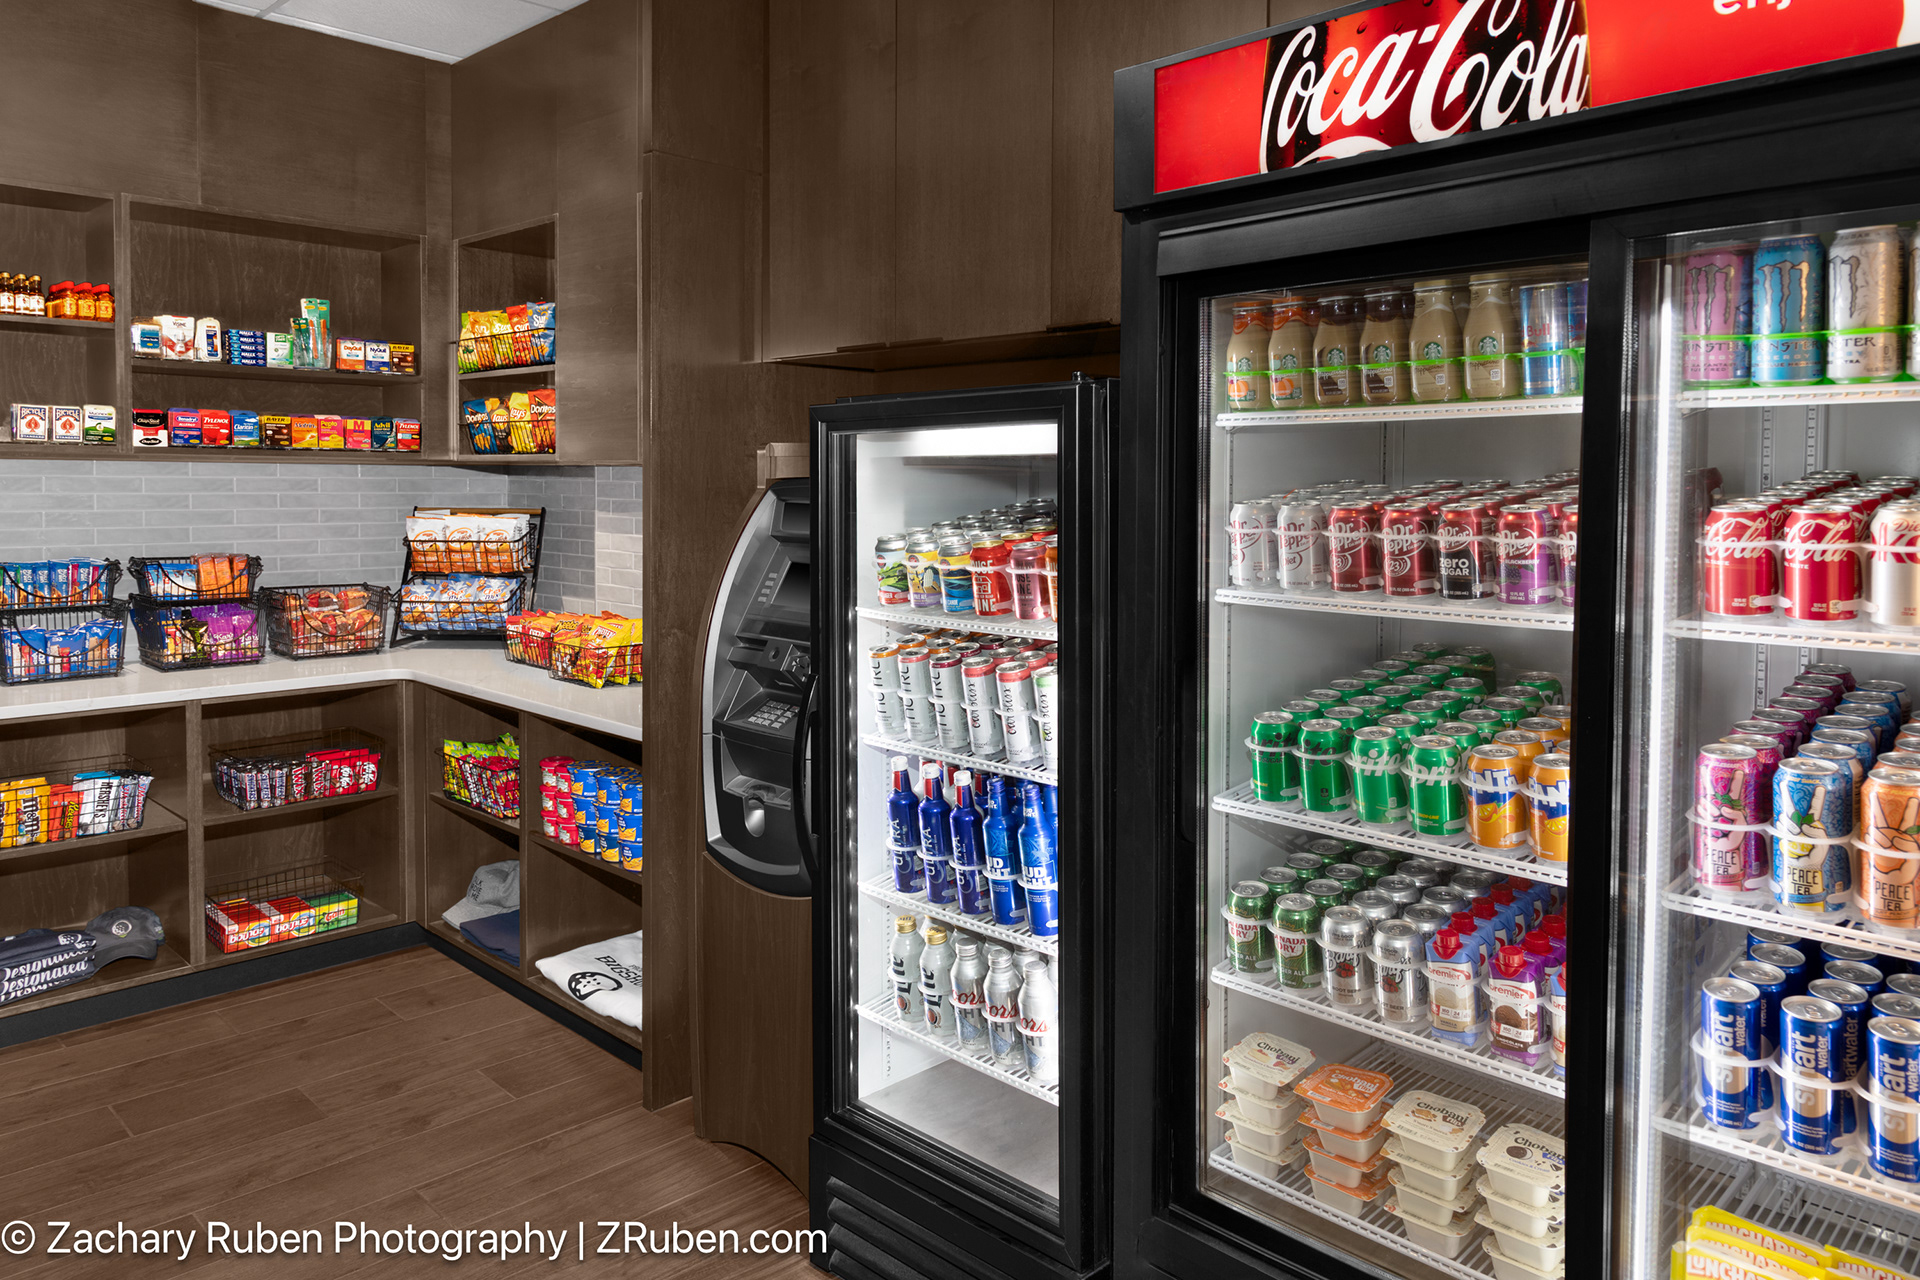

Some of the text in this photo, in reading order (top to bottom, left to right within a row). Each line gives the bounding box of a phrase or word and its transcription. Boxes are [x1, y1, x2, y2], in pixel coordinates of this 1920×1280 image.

[1260, 0, 1590, 160] Coca-Cola
[1526, 324, 1551, 338] Bull
[20, 408, 46, 418] BICYCLE
[56, 408, 80, 418] BICYCLE
[530, 404, 556, 414] Doritos
[204, 416, 229, 425] TYLENOL
[1705, 517, 1766, 559] Cola
[1784, 518, 1851, 562] Cola
[1440, 568, 1470, 577] SUGAR
[978, 598, 997, 612] INE
[555, 620, 579, 634] Cheetos
[292, 765, 307, 798] TWIX
[312, 761, 327, 796] TWIX
[1528, 764, 1570, 807] FAN
[892, 817, 904, 866] ULTRA
[922, 826, 936, 876] ULTRA
[954, 834, 966, 886] ULTRA
[1875, 880, 1911, 902] PEACE
[1278, 943, 1297, 954] DRY
[1428, 966, 1462, 982] premier
[952, 989, 986, 1006] ors
[1490, 984, 1525, 1001] premier
[1019, 1017, 1050, 1034] ors
[1440, 1018, 1458, 1028] VANILLA
[1256, 1040, 1301, 1064] Chobani
[1331, 1072, 1380, 1093] Chobani
[1416, 1101, 1470, 1126] Chobani
[1514, 1136, 1565, 1161] Choban
